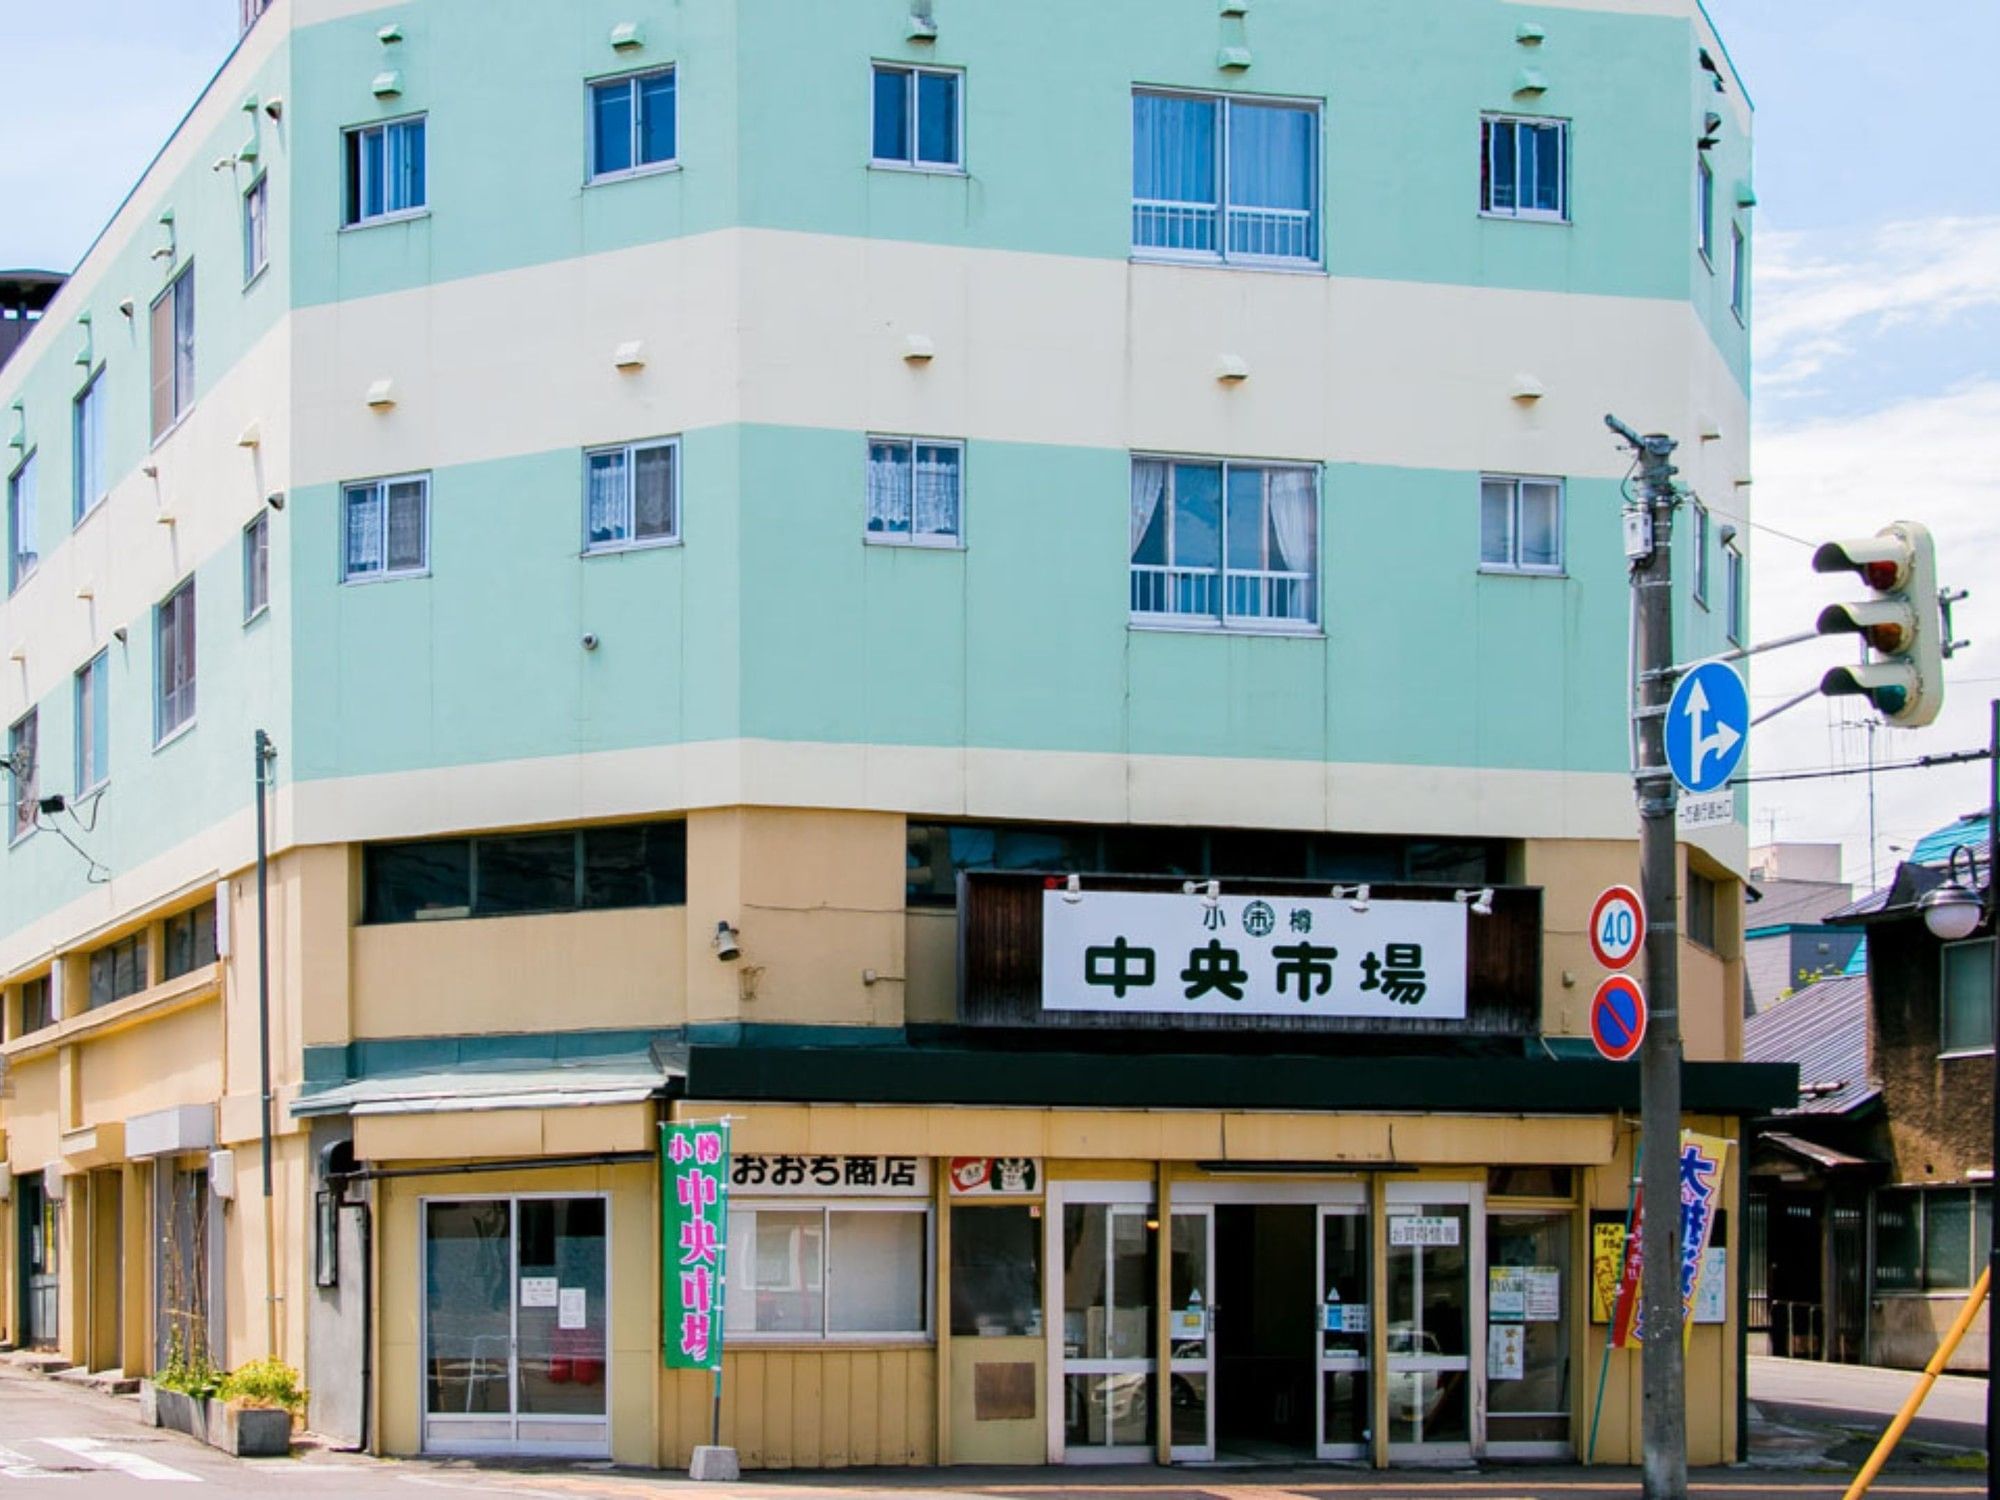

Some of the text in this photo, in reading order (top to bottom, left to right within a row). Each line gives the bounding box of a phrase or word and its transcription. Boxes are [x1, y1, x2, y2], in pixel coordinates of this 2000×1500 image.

[1602, 910, 1632, 947] 40
[1084, 935, 1427, 1006] 中央市場
[732, 1154, 917, 1187] おおち商店
[677, 1168, 717, 1361] 中央市場
